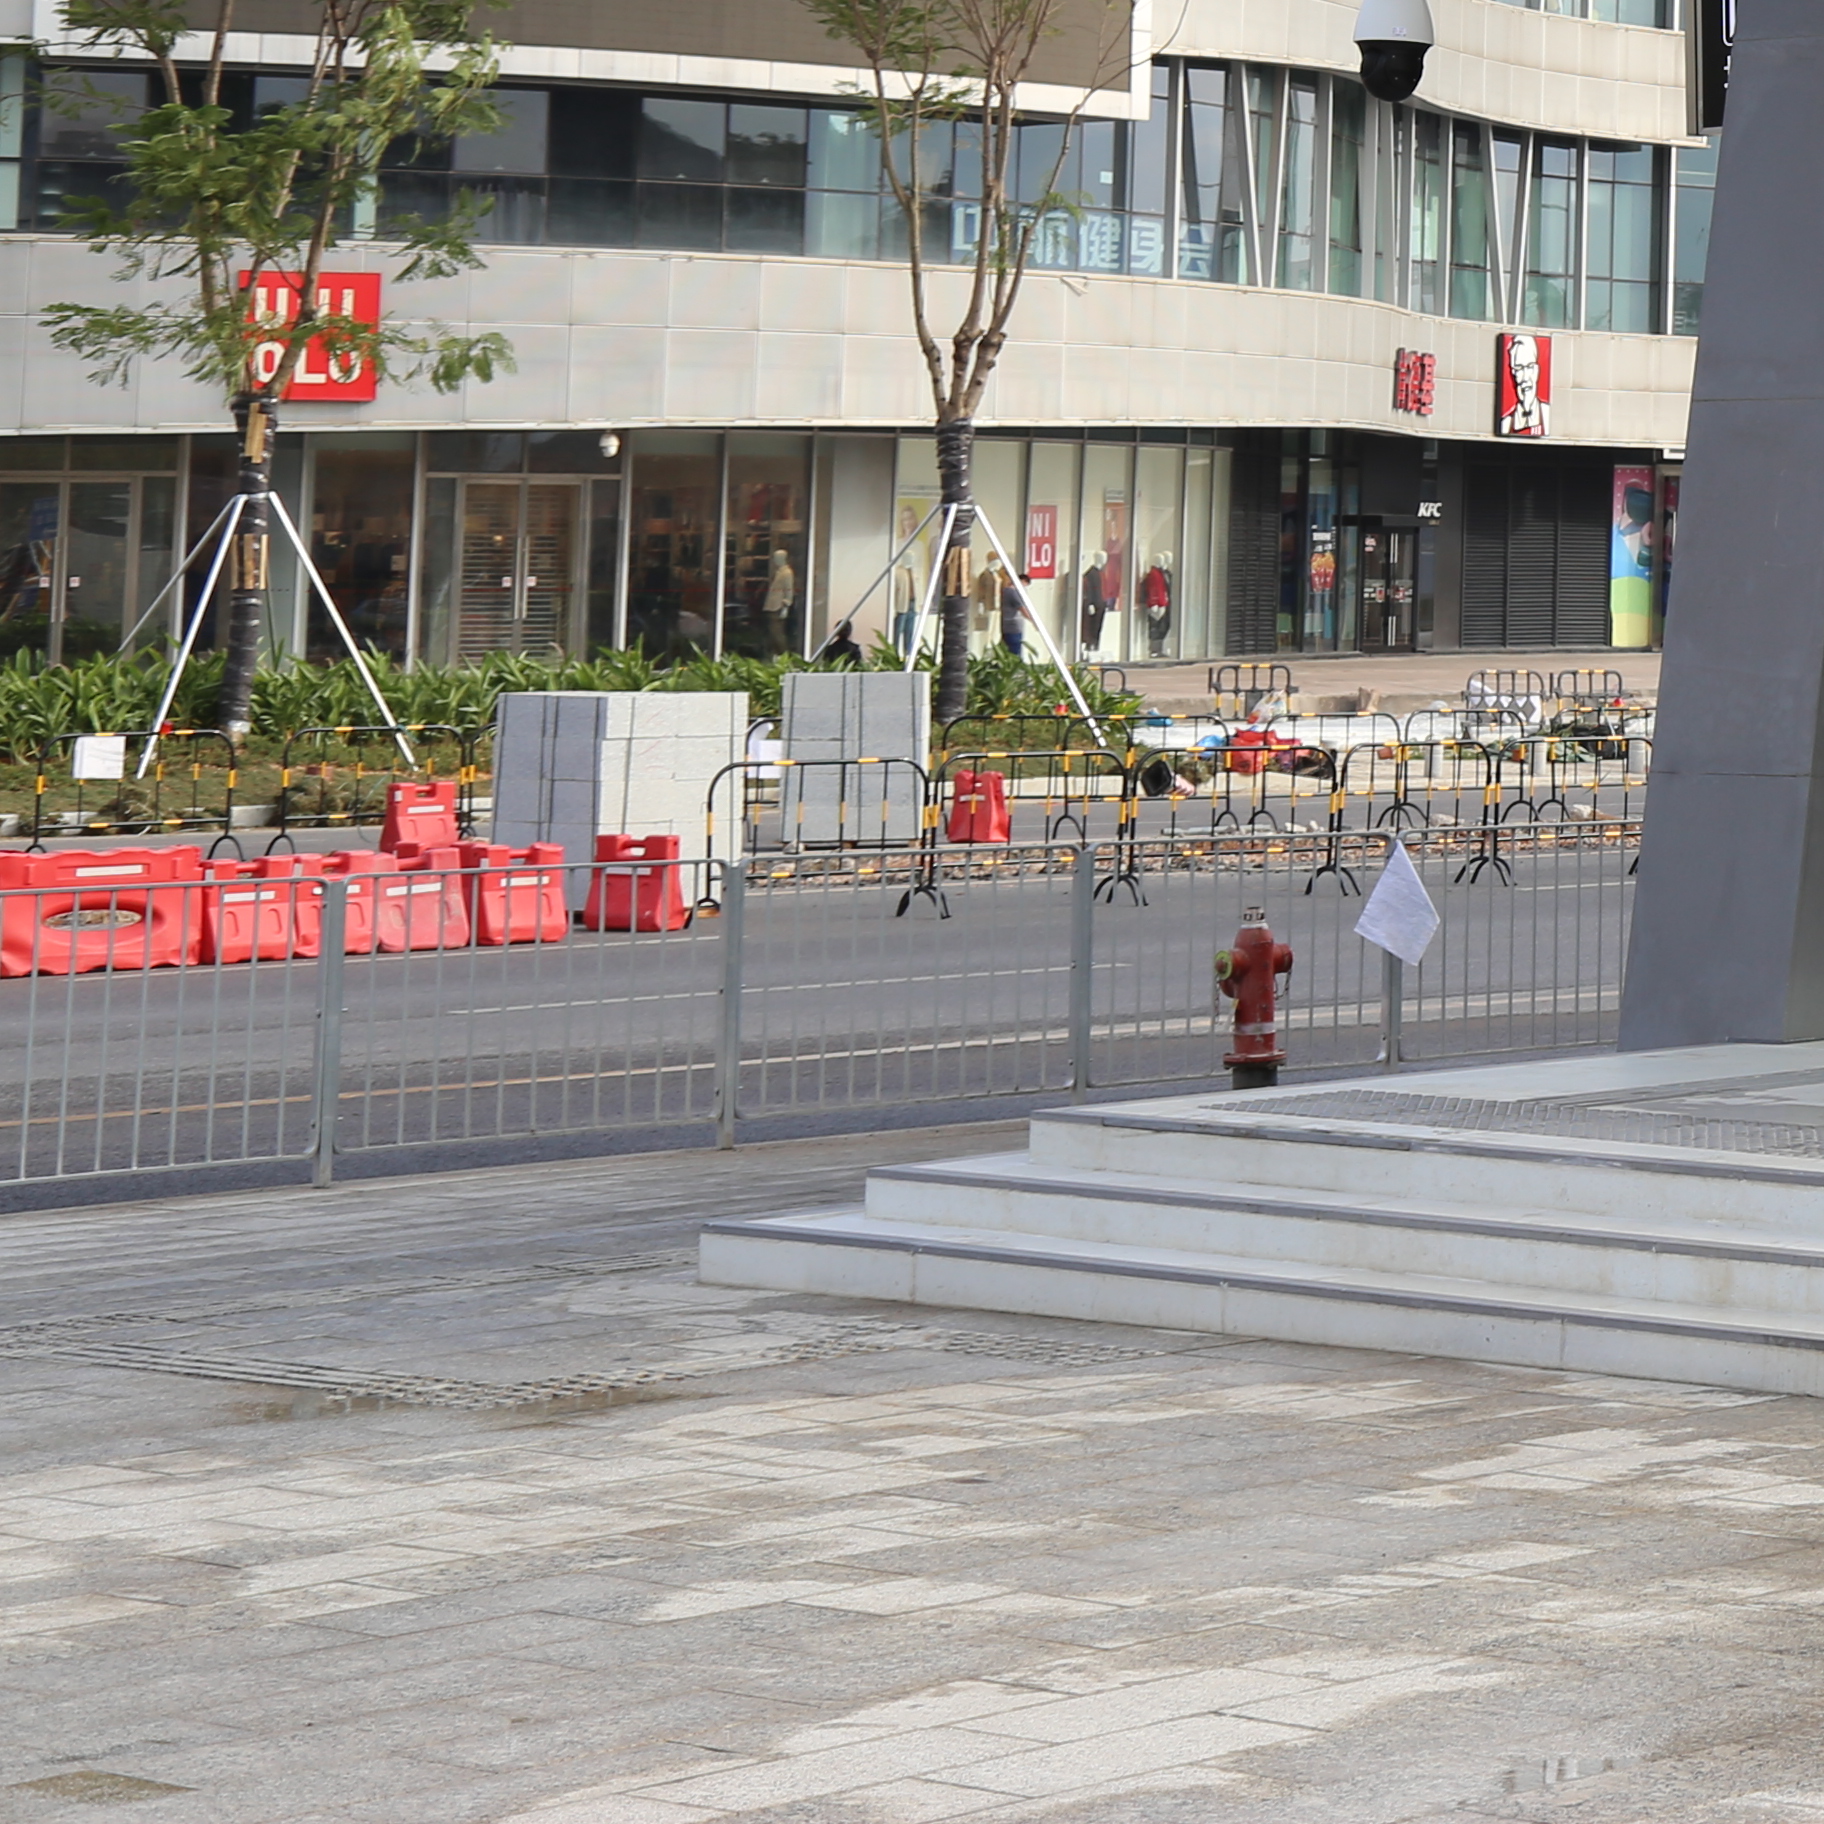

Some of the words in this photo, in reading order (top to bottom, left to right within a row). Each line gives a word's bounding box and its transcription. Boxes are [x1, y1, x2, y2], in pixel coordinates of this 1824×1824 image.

[1417, 502, 1443, 518] KFC
[1028, 513, 1050, 537] NI
[1028, 543, 1052, 568] LO
